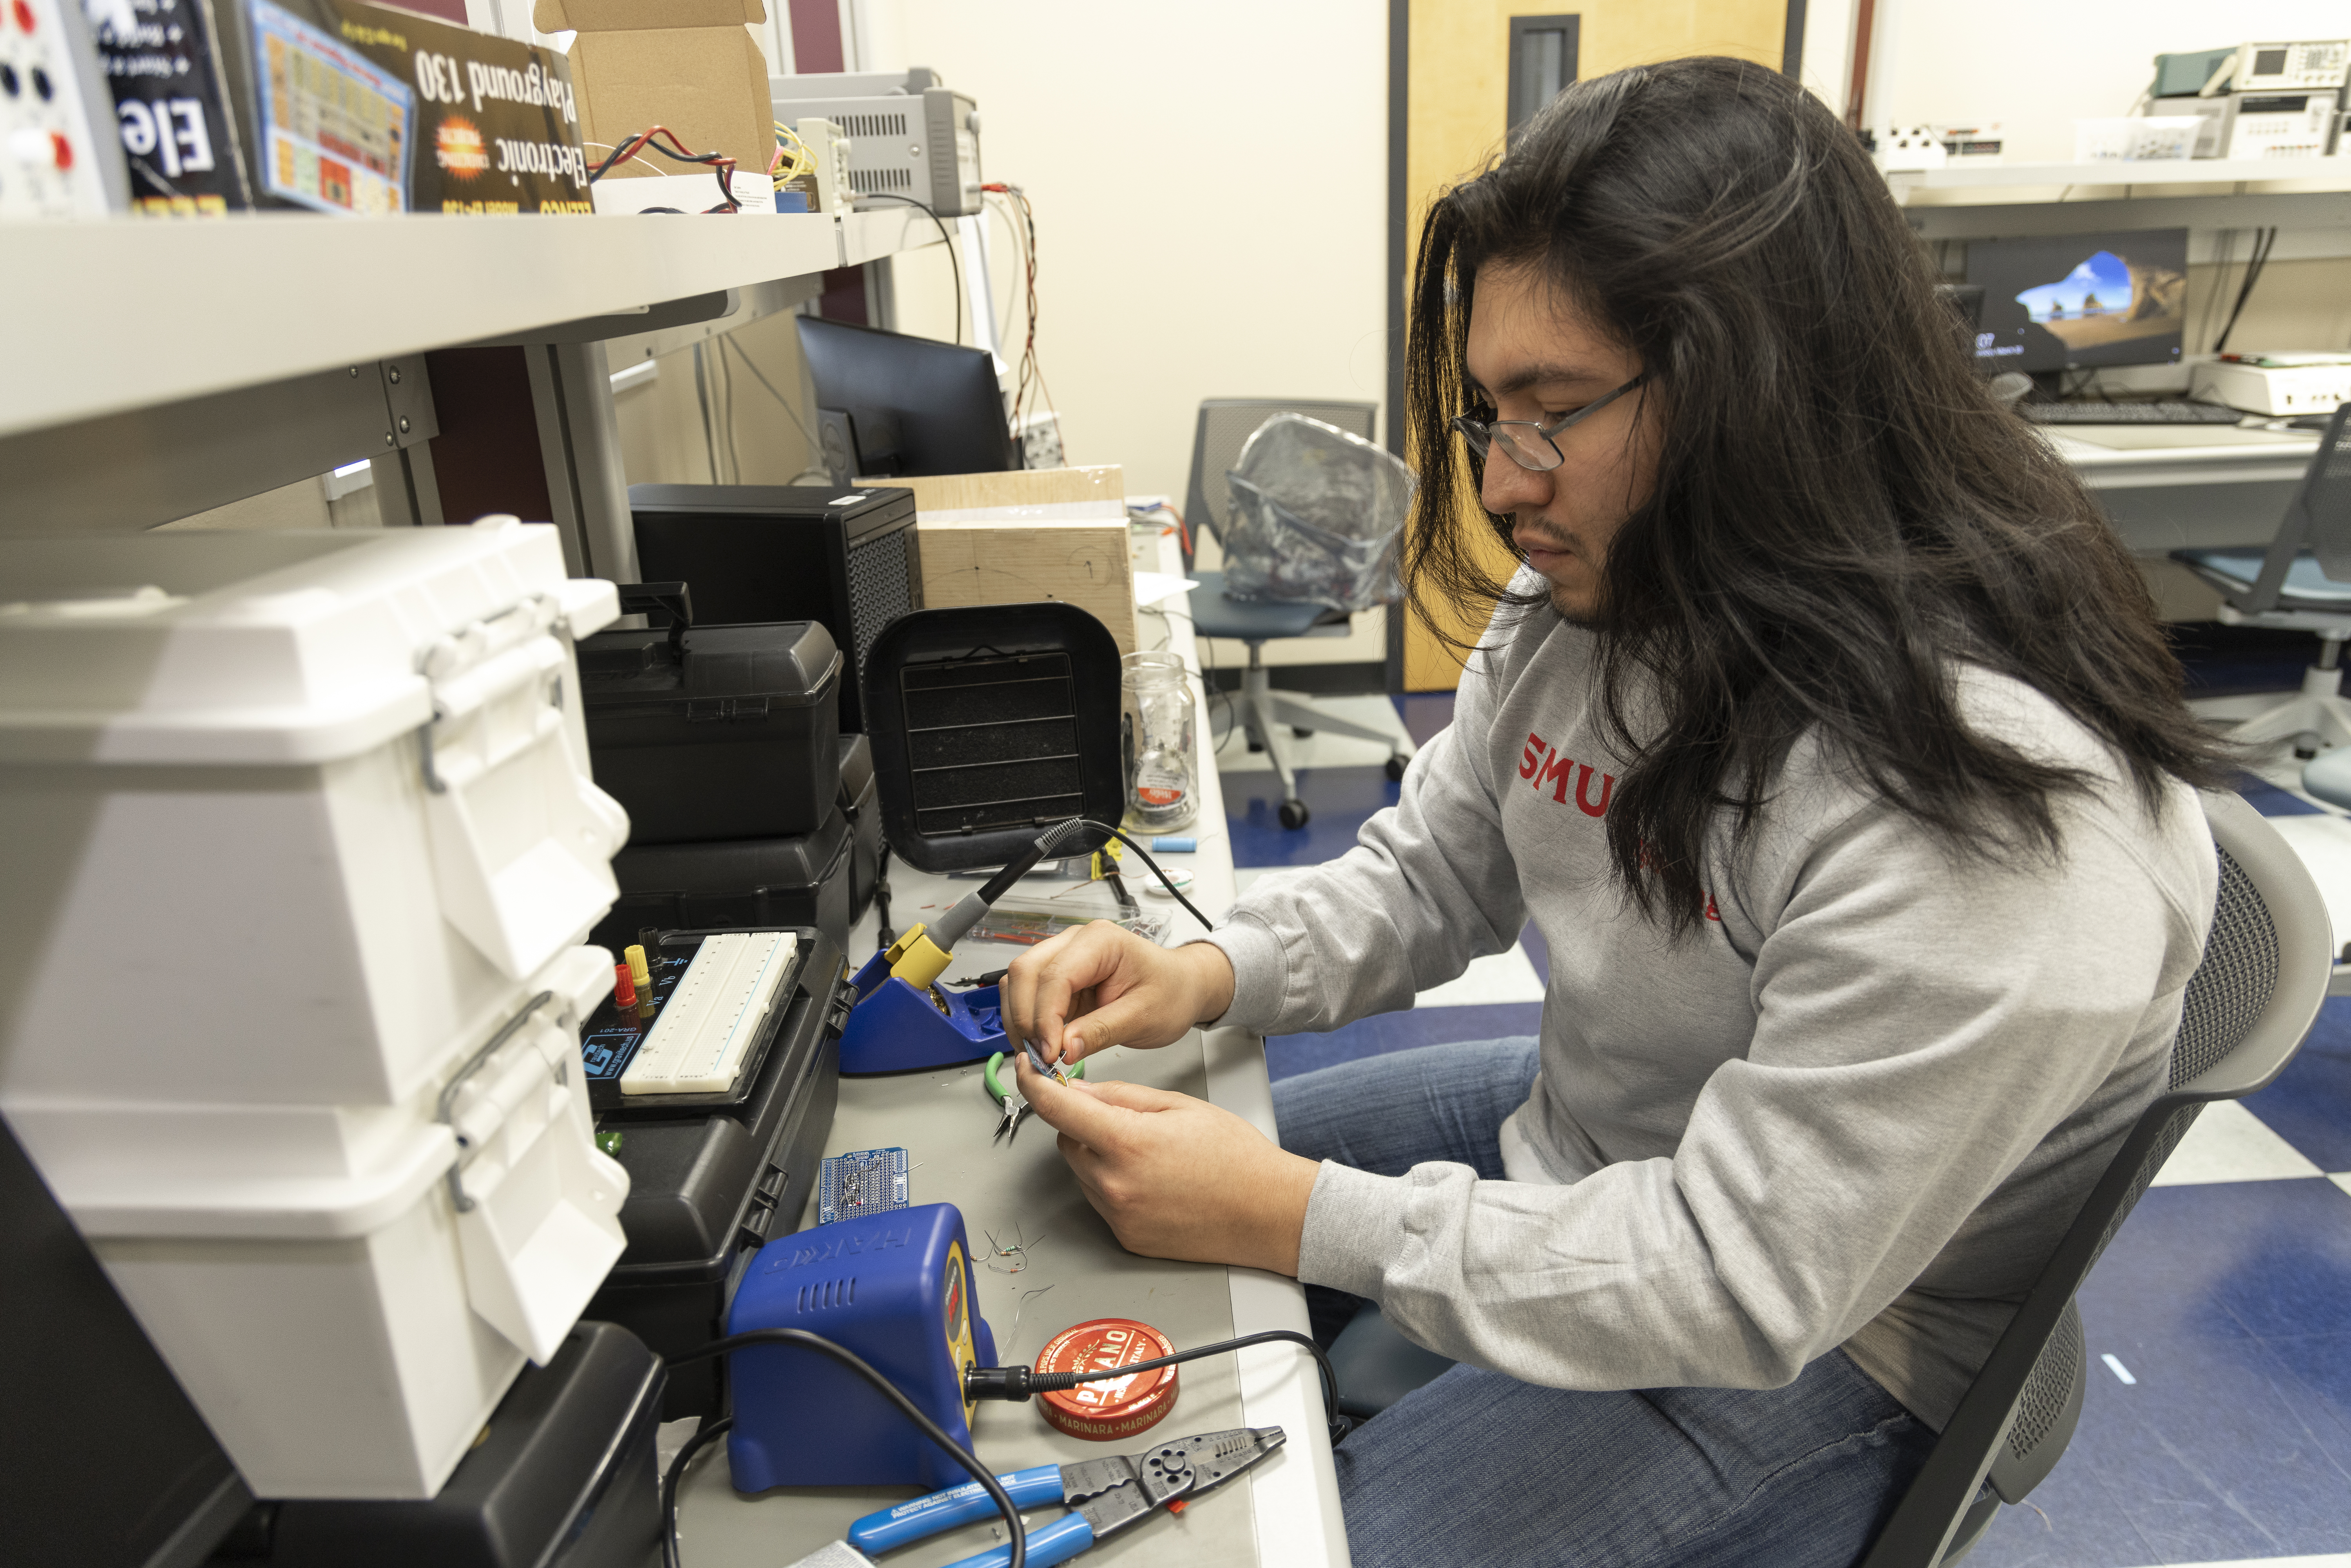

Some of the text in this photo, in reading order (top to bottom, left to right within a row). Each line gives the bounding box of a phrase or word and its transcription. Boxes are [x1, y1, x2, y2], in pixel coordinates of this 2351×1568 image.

[415, 49, 577, 124] Playground 130
[495, 138, 588, 190] Electronic
[1519, 731, 1615, 818] SMU
[659, 975, 676, 987] Vb
[647, 996, 664, 1007] Va
[604, 1036, 634, 1076] www.gravitech.us
[1040, 1356, 1048, 1369] POPS
[1130, 1340, 1147, 1363] ITALY
[1059, 1403, 1167, 1434] MARINARA MARINARA
[923, 1496, 952, 1508] AGAINST
[931, 1493, 947, 1502] NOT
